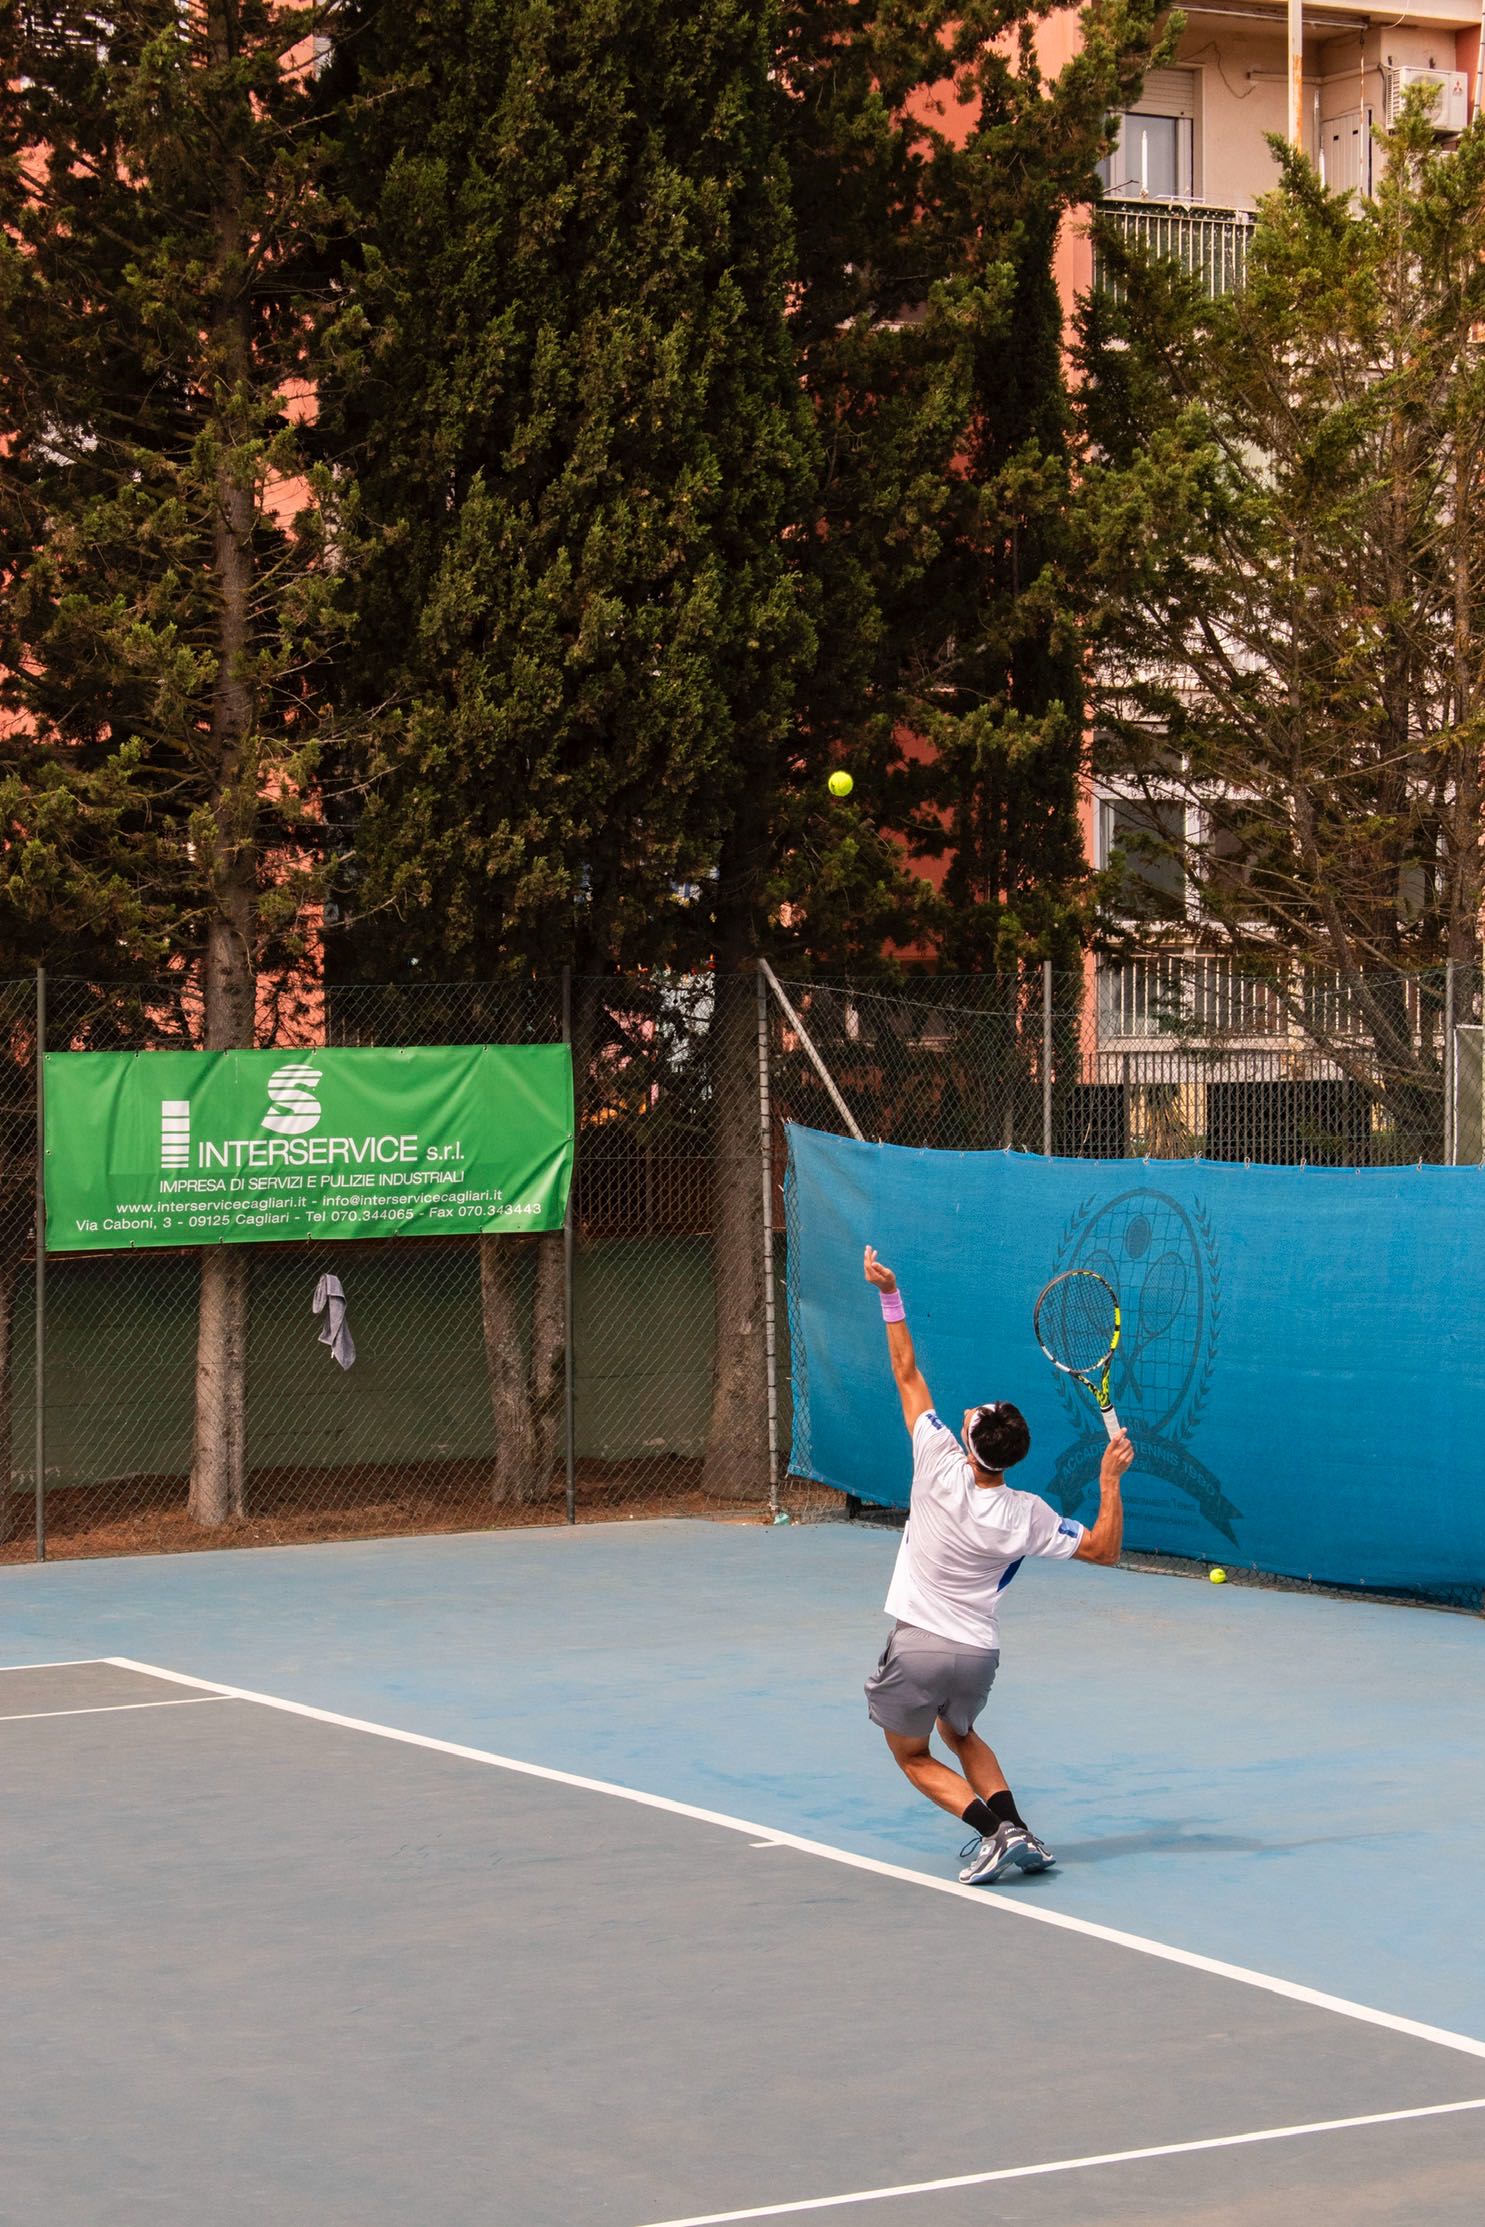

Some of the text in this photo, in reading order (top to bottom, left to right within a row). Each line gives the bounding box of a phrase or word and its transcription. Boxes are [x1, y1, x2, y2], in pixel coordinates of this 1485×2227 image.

[199, 1135, 465, 1168] INTERSERVICE s.r.l.
[160, 1171, 465, 1193] IMPRESA DI SERVIZI E PULIZIE INDUSTRIALI
[116, 1197, 307, 1214] www.interservicecagliari.it
[322, 1189, 503, 1207] info@interservicecagliari.it
[76, 1219, 99, 1232] Via
[102, 1217, 157, 1231] Caboni,
[163, 1216, 172, 1228] 3
[188, 1215, 230, 1228] 09125
[235, 1212, 290, 1228] Cagliari
[305, 1210, 326, 1222] Tel
[331, 1208, 414, 1222] 070.344065
[429, 1207, 454, 1218] Fax
[457, 1202, 542, 1218] 070.343443
[1062, 1441, 1107, 1475] ACCADE
[1134, 1440, 1179, 1466] TENNIS
